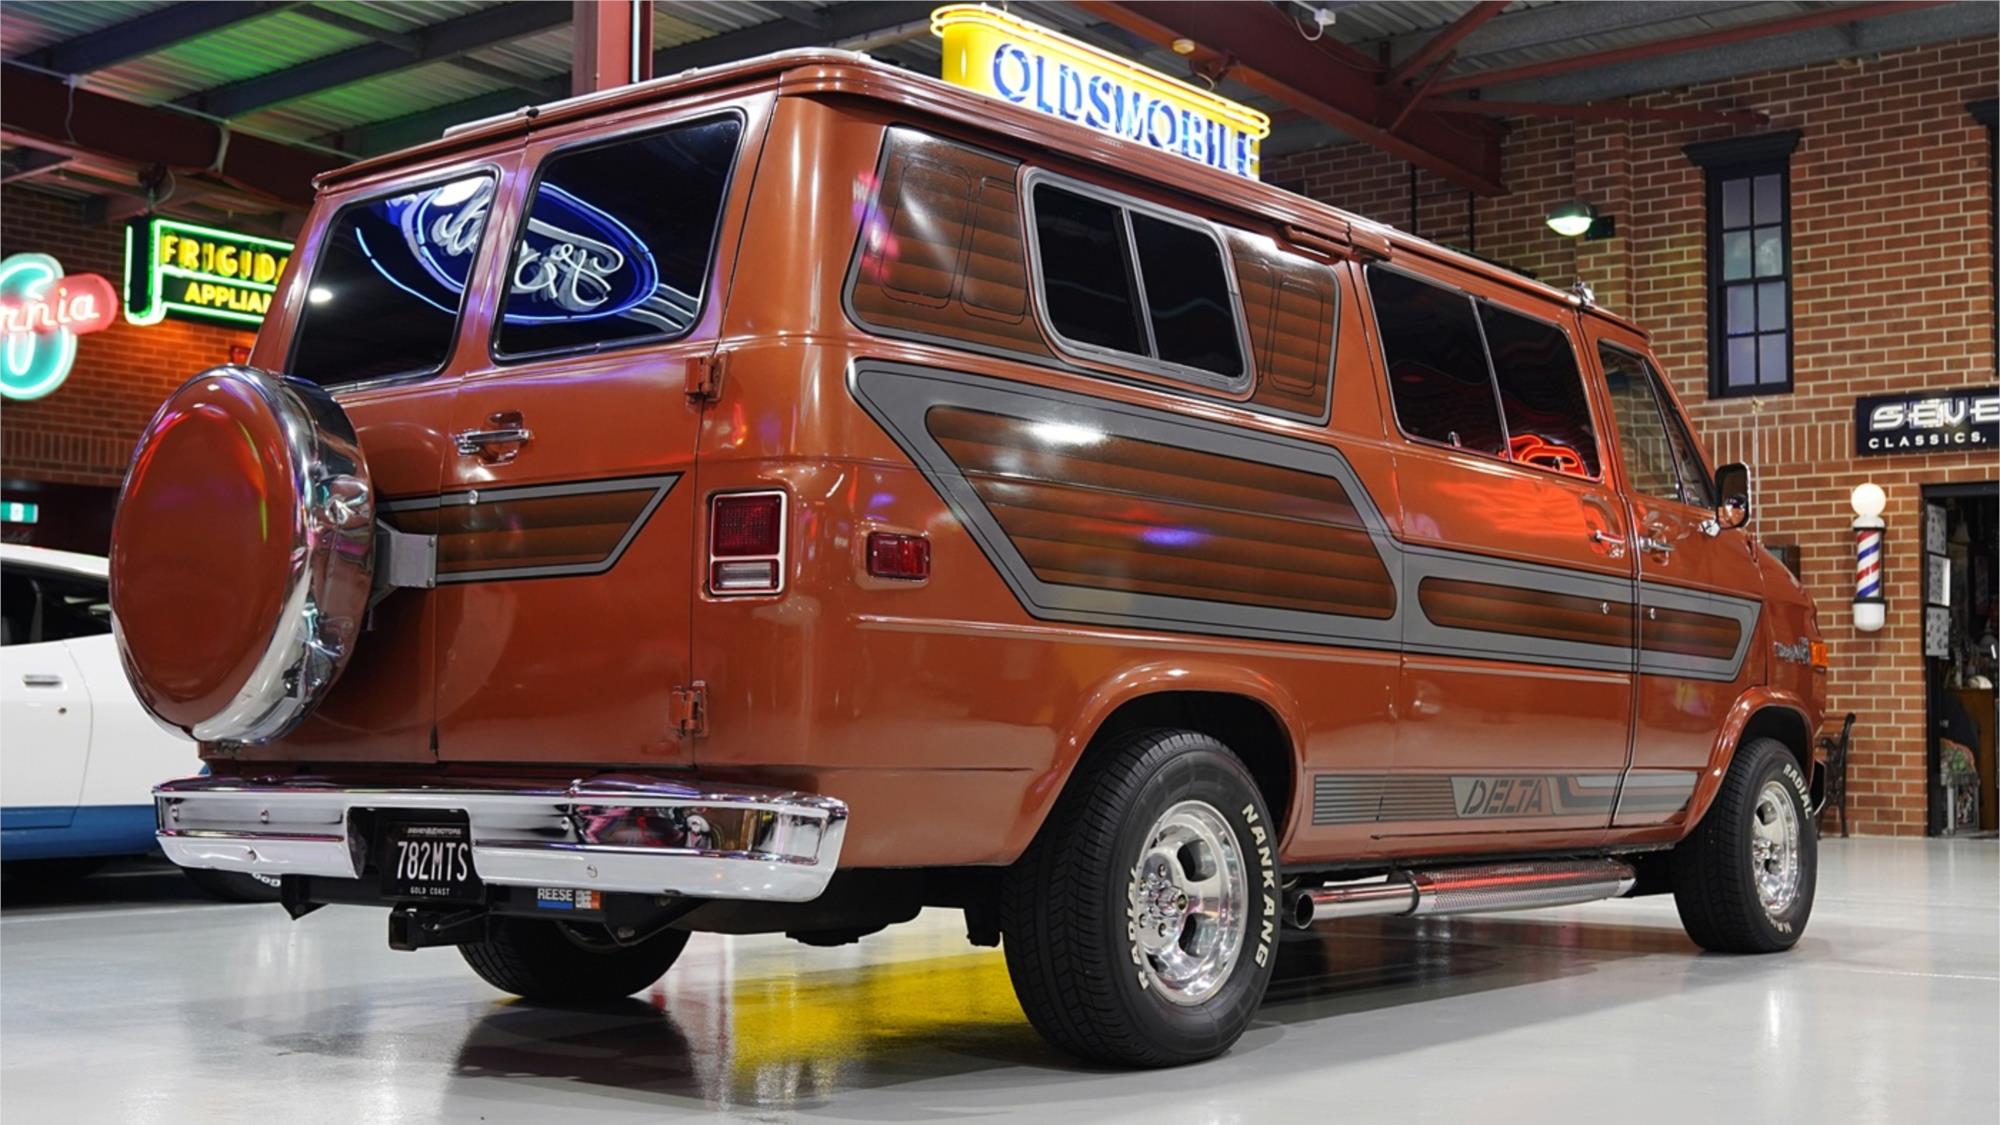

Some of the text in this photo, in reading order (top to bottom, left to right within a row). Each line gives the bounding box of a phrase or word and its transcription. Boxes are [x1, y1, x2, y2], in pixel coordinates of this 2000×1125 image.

[993, 43, 1259, 178] OLDSMOBILE
[1868, 431, 1987, 449] CLASSICS,
[1461, 779, 1543, 815] DELTA
[1783, 763, 1812, 820] RADIAL
[397, 841, 469, 882] 782MTS
[410, 885, 451, 896] GOLD COAST
[537, 887, 574, 902] REESE
[1242, 803, 1276, 968] NANKANG
